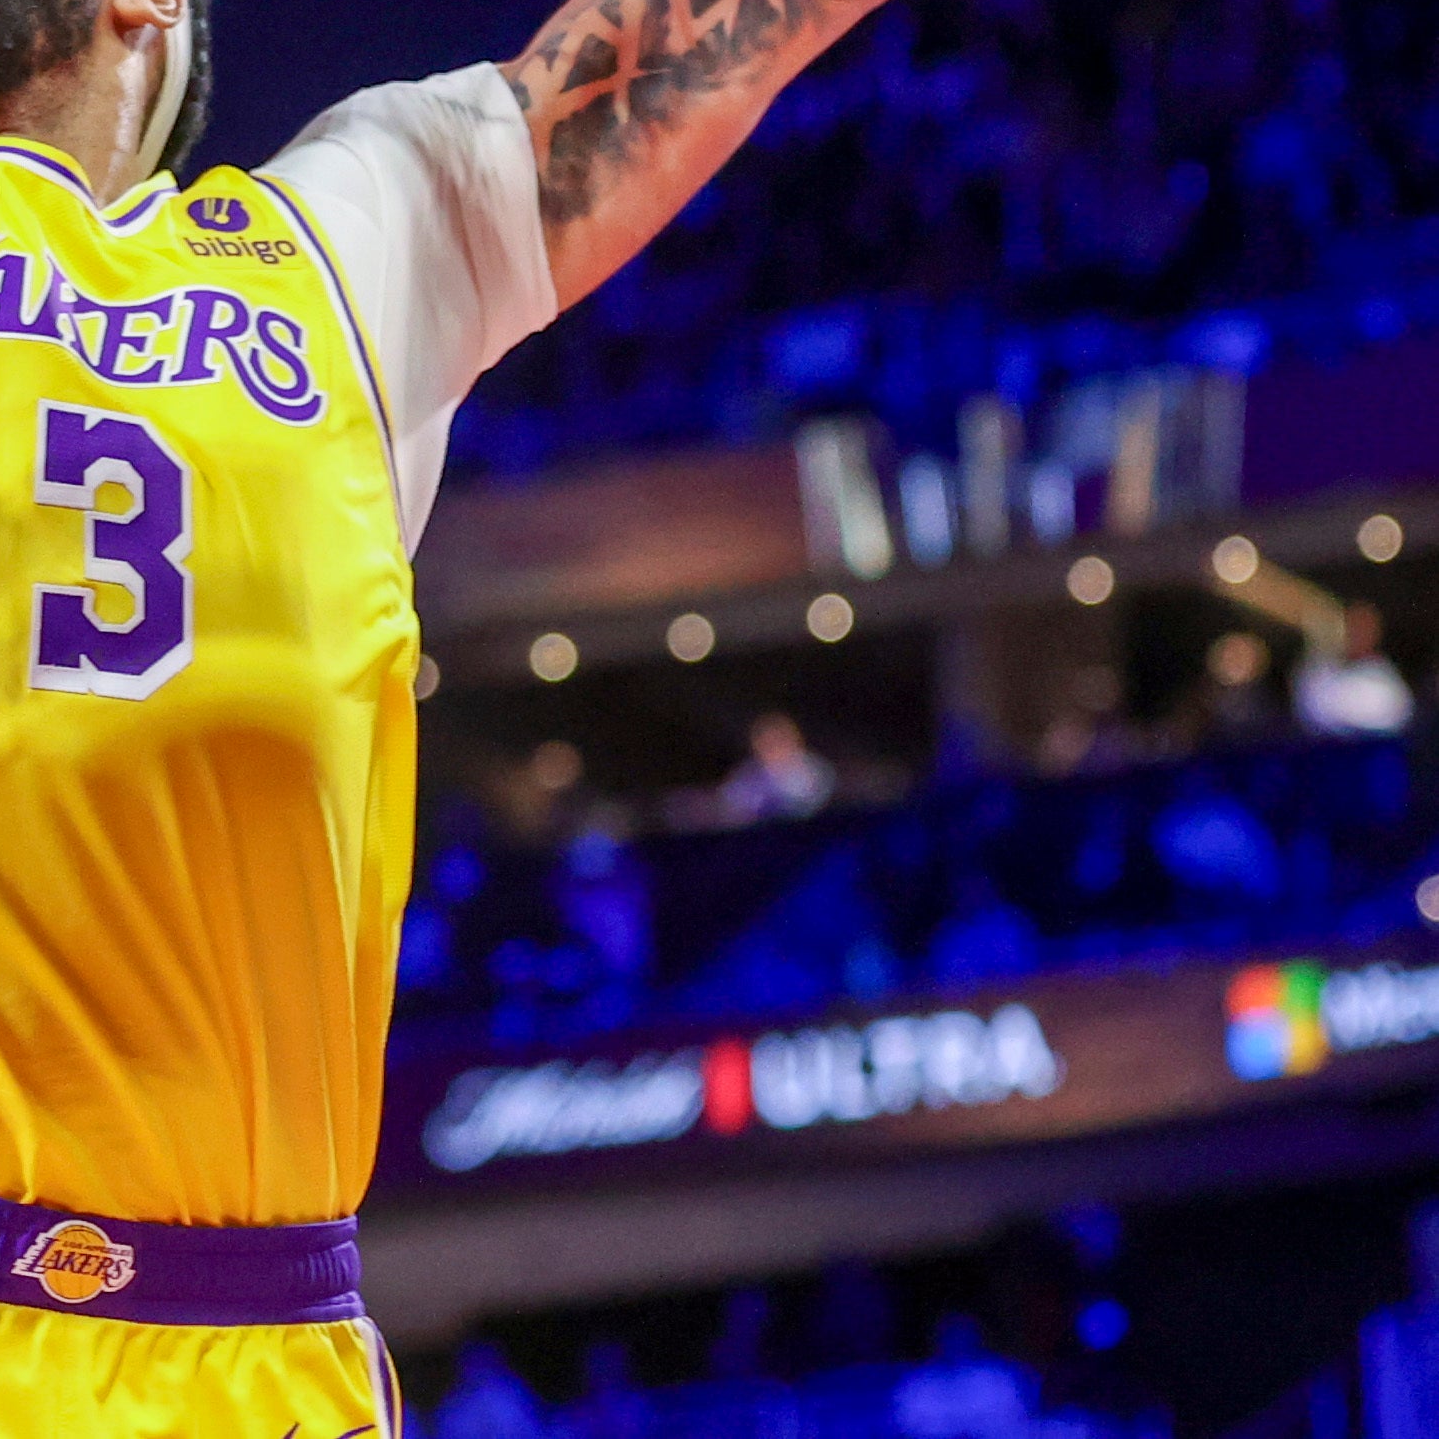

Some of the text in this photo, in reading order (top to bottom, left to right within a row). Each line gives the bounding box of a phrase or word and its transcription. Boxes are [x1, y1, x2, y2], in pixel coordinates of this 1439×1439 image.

[183, 235, 297, 264] bibigo
[29, 397, 193, 702] 3
[13, 1235, 134, 1289] LAKERS
